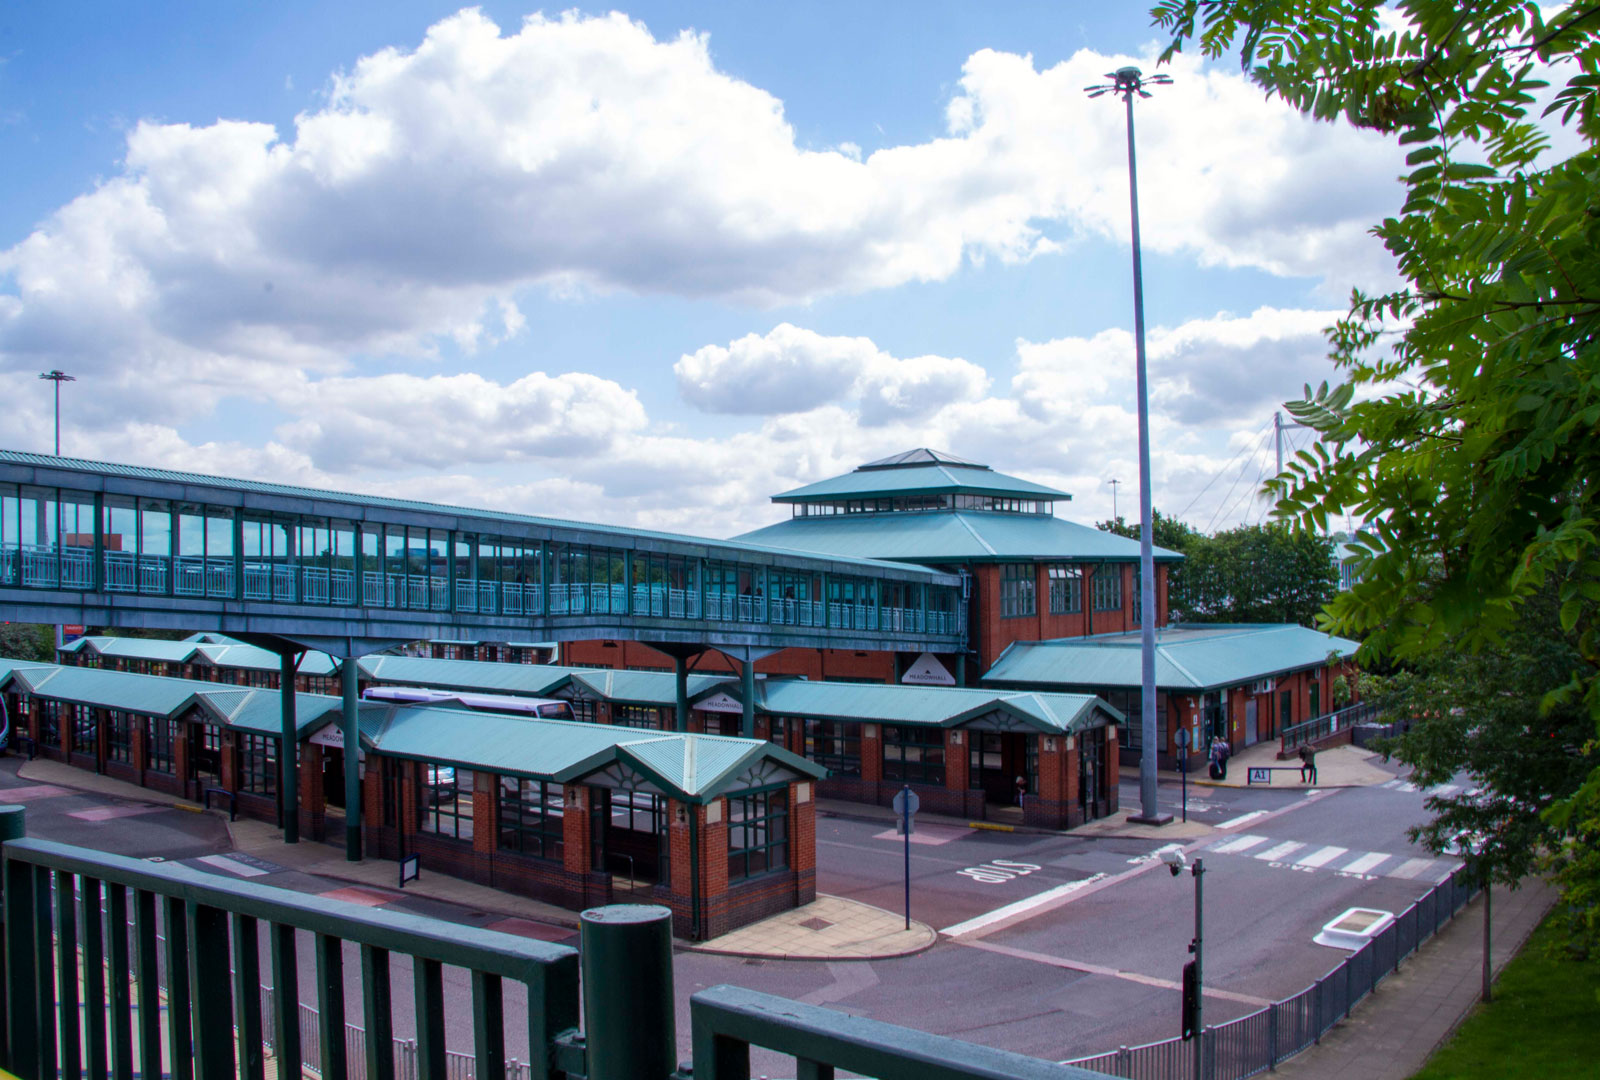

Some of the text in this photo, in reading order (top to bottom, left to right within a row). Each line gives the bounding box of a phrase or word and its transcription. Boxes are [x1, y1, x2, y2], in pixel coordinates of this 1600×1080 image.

[322, 734, 344, 742] MEADOW
[1254, 770, 1266, 779] A1
[956, 860, 1042, 883] STOP
